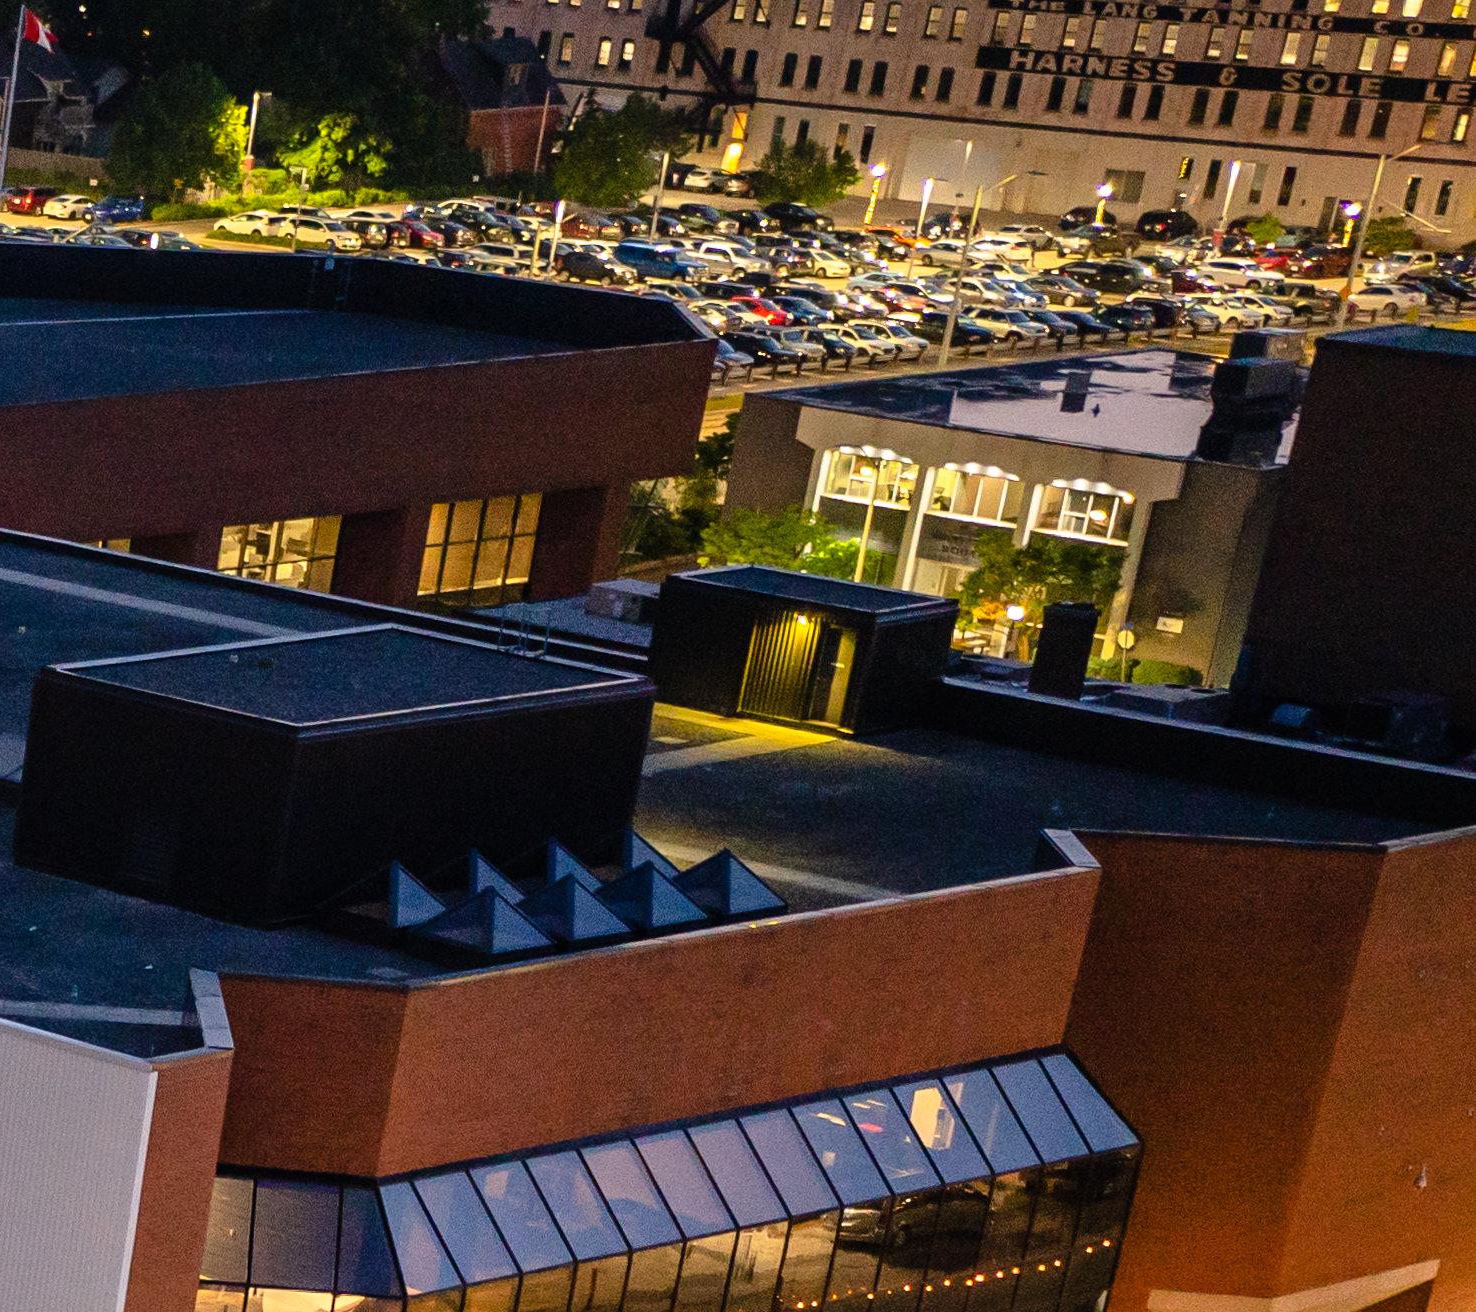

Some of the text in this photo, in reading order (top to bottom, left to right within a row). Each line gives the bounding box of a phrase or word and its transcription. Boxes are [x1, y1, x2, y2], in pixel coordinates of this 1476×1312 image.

[1081, 0, 1161, 18] LANG
[1178, 7, 1337, 30] TANNING
[1011, 50, 1175, 82] HARNESS
[1218, 65, 1238, 84] &
[1284, 70, 1386, 96] SOLE
